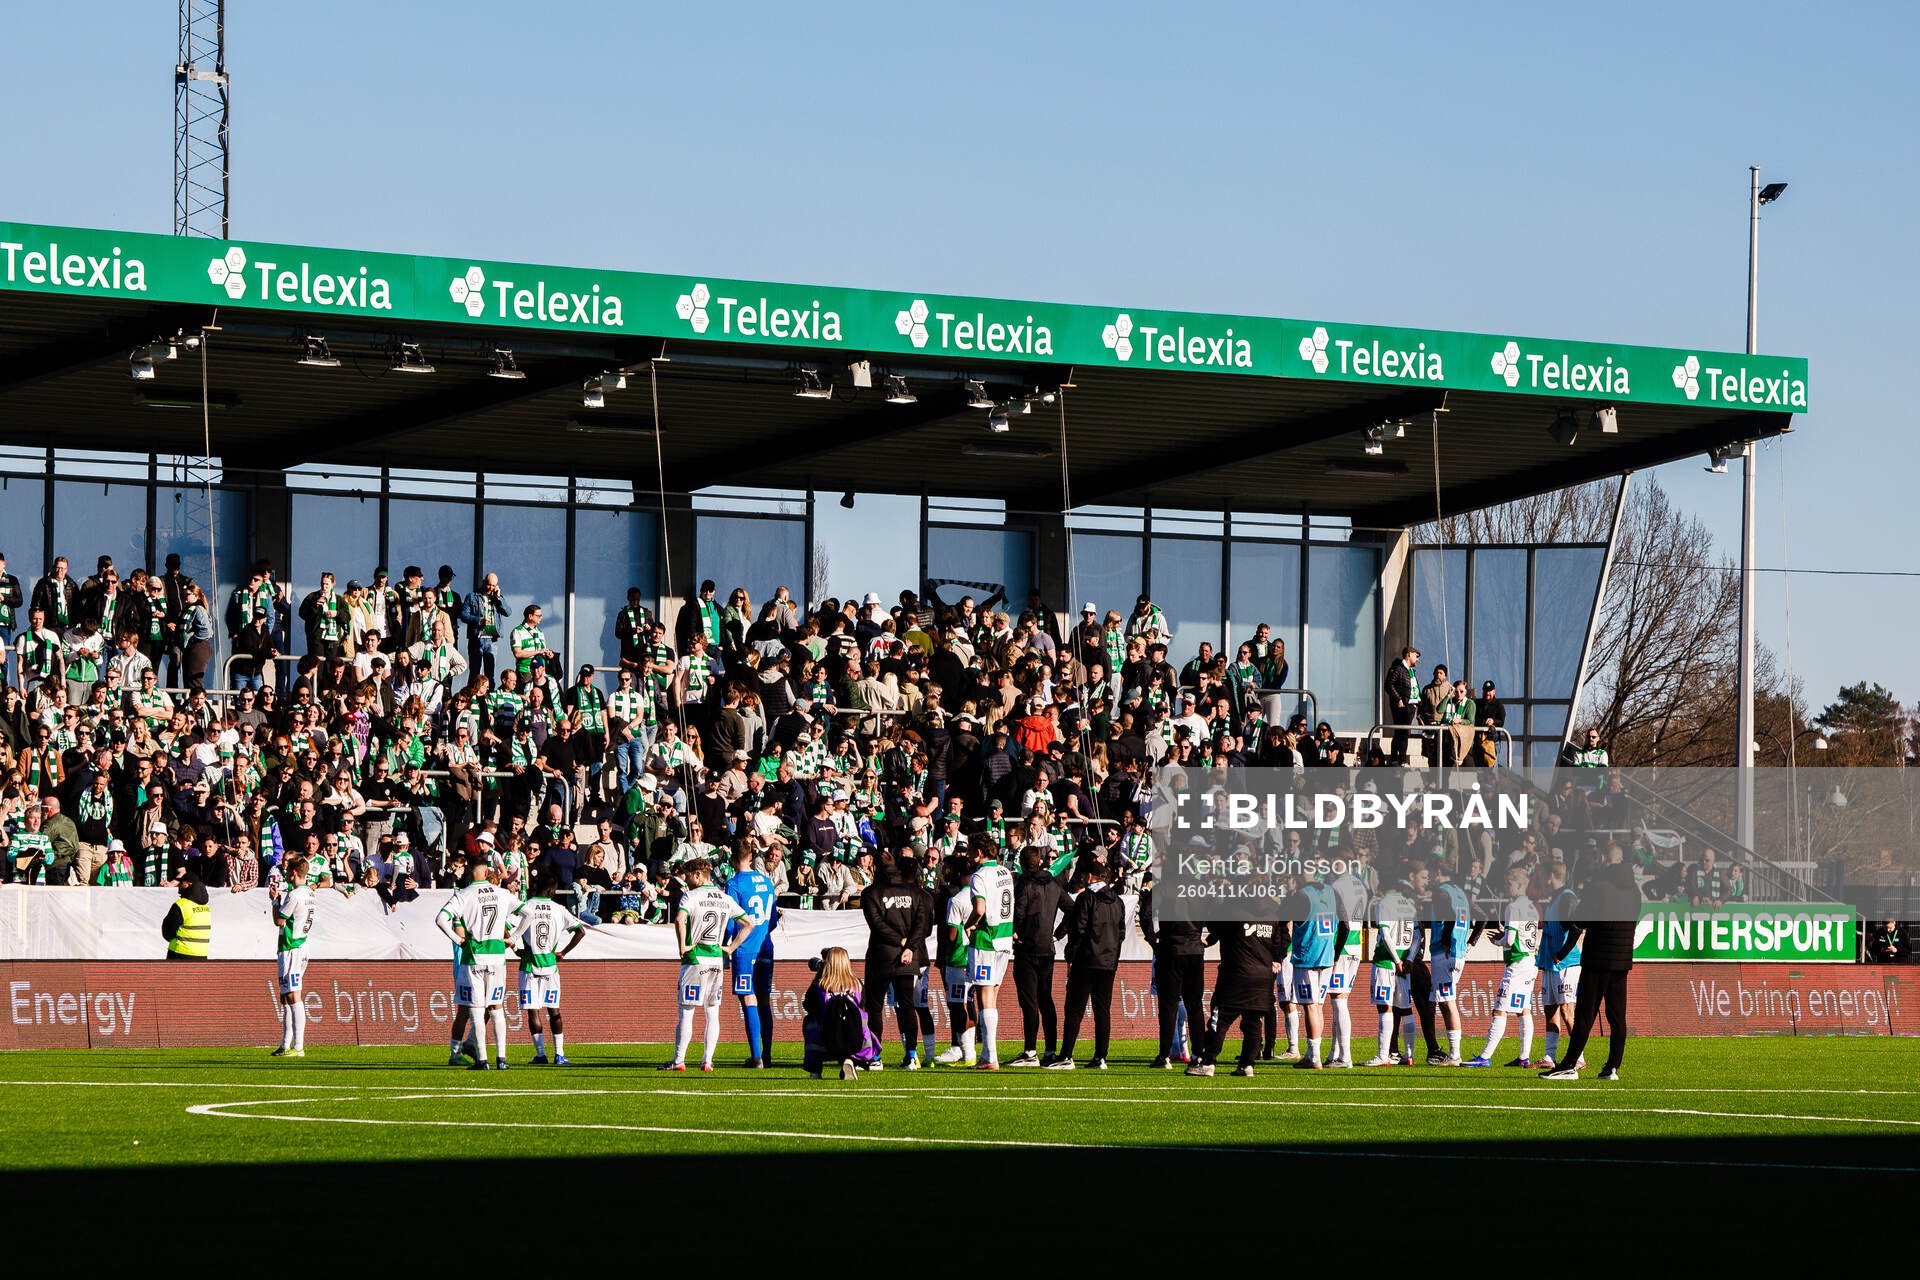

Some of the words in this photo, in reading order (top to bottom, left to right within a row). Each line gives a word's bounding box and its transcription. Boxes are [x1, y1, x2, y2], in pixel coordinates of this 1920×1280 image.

[0, 242, 146, 290] Telexia
[255, 262, 391, 309] Telexia
[493, 281, 623, 325] Telexia
[718, 298, 842, 340] Telexia
[936, 313, 1053, 354] Telexia
[1140, 327, 1252, 367] Telexia
[1336, 340, 1443, 380] Telexia
[1527, 355, 1629, 393] Telexia
[1706, 368, 1806, 407] Telexia
[482, 904, 498, 936] 7
[1000, 889, 1012, 919] 9
[536, 921, 550, 950] 8
[1396, 917, 1414, 946] 15
[1525, 920, 1537, 950] 3
[1658, 912, 1850, 951] INTERSPORT
[9, 981, 136, 1035] Energy
[333, 980, 419, 1033] bring
[1690, 979, 1731, 1016] We
[1737, 979, 1801, 1026] bring
[1808, 979, 1900, 1026] energy!
